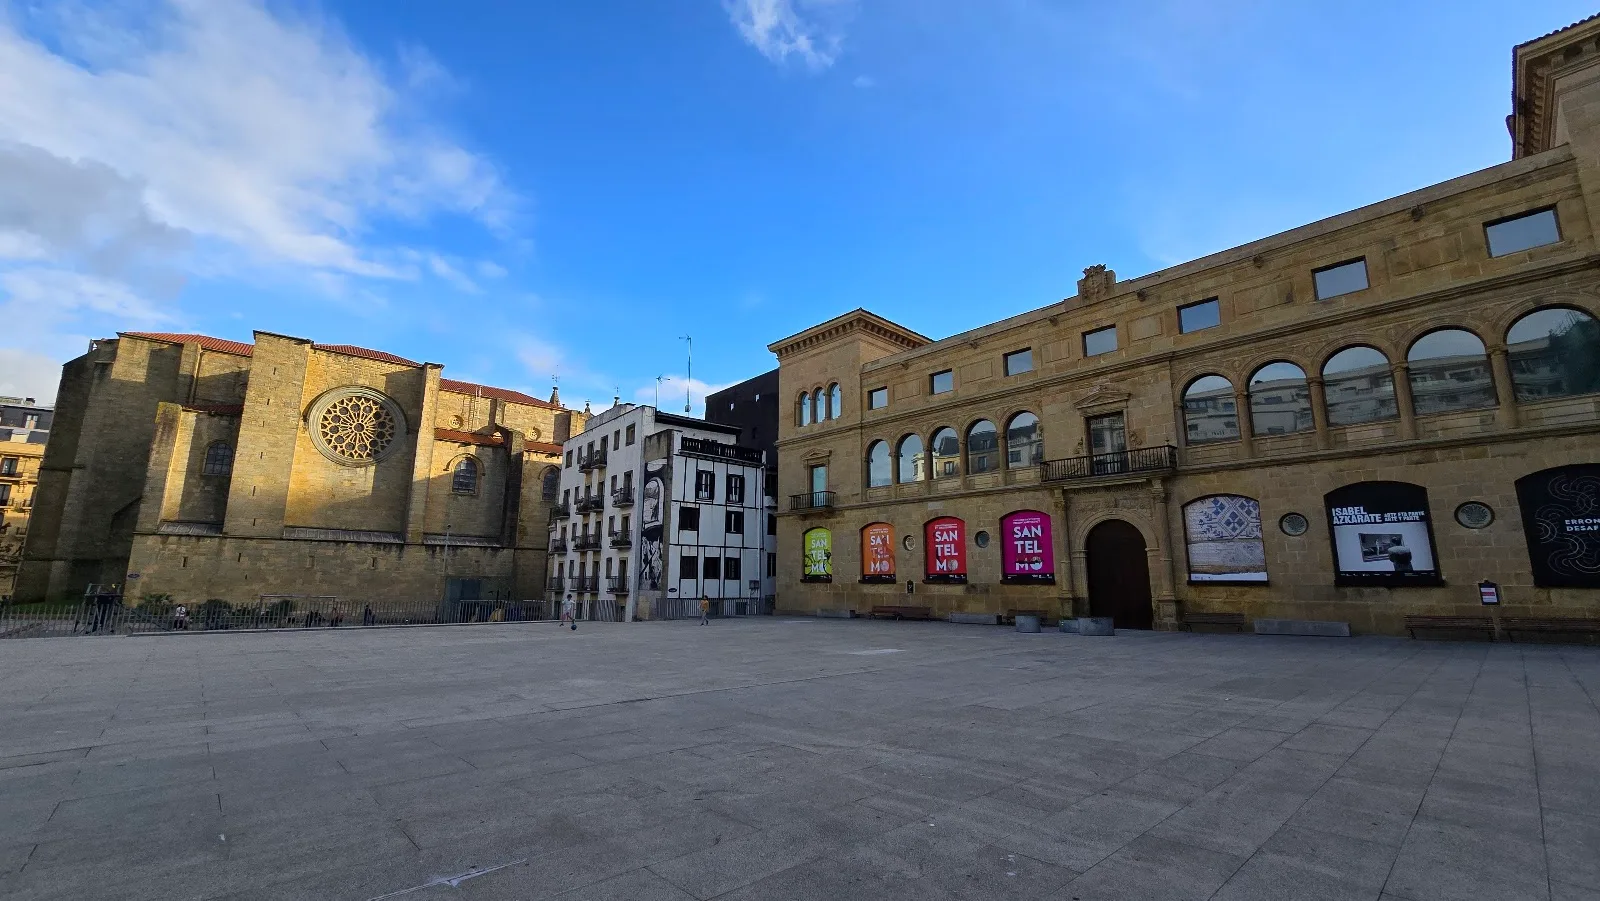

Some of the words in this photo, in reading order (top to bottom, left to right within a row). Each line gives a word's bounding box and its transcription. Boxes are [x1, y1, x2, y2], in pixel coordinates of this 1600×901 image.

[1332, 506, 1367, 516] ISABEL
[1333, 514, 1382, 524] AZKARATE
[935, 531, 958, 542] SAN
[1014, 525, 1042, 538] SAN
[812, 538, 828, 548] SAN
[1014, 541, 1042, 553] TEL
[811, 550, 827, 560] TEL
[936, 544, 958, 556] TEL
[870, 560, 890, 572] MO
[936, 558, 958, 571] MO
[1016, 557, 1042, 570] MO
